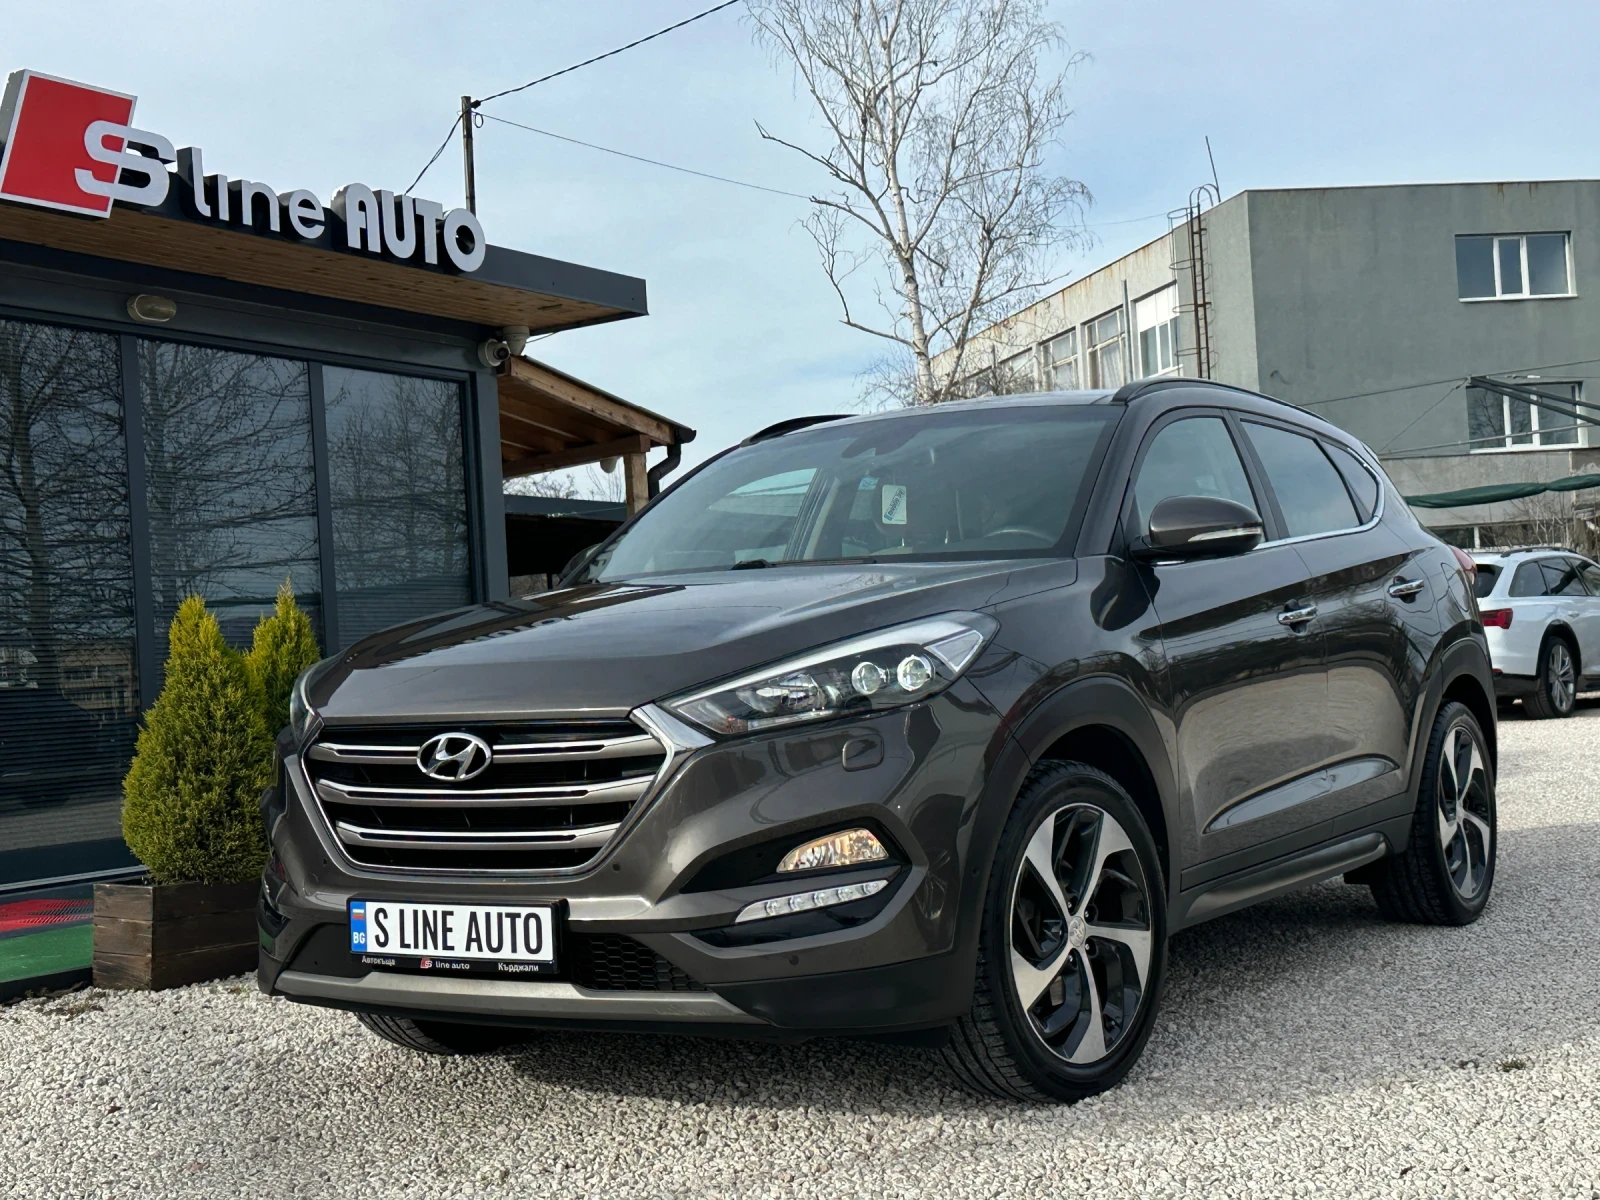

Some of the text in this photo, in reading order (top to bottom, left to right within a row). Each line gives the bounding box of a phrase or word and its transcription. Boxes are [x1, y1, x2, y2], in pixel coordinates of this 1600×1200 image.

[74, 120, 175, 207] S
[346, 182, 486, 273] AUTO
[353, 932, 366, 945] BG
[374, 907, 543, 954] S LINE AUTO
